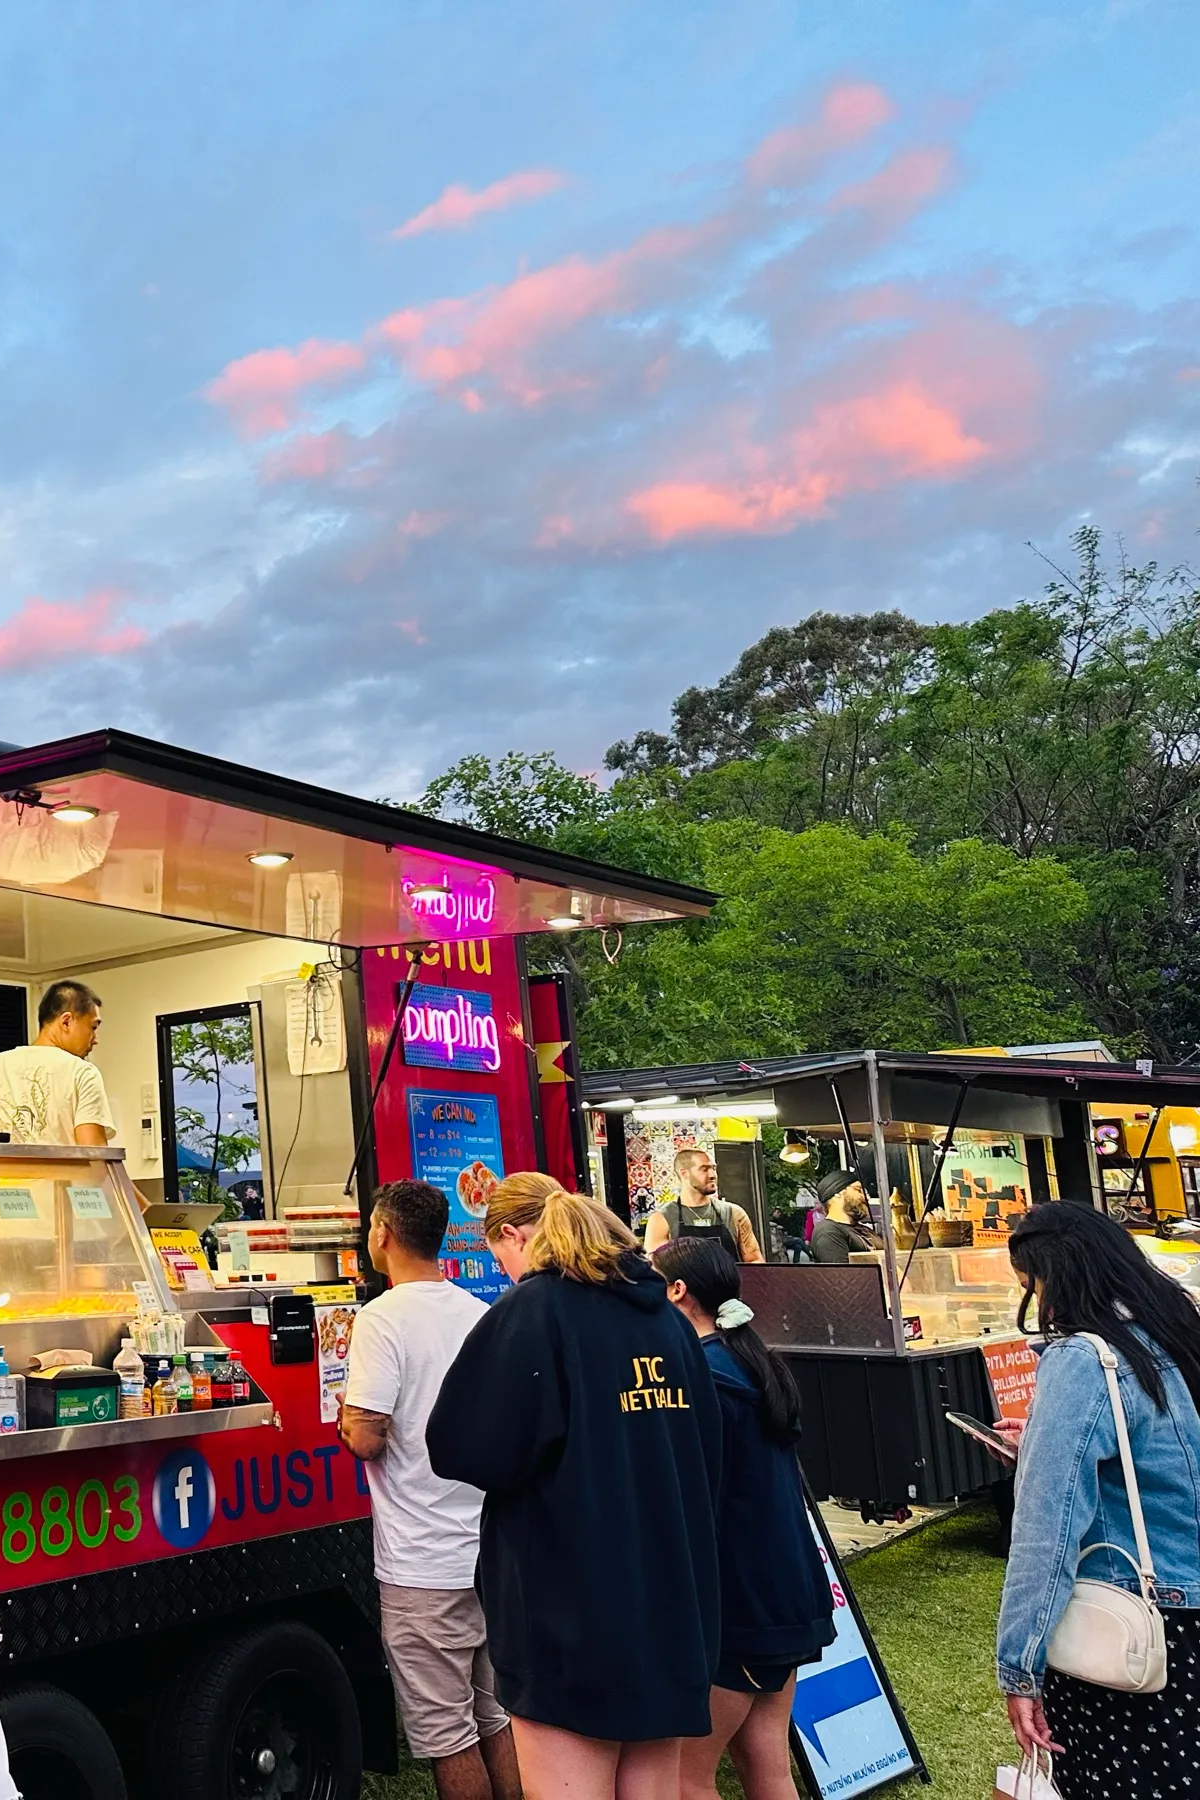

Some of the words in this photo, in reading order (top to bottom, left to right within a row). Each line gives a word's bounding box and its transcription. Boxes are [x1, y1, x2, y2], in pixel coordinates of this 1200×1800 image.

[431, 1104, 445, 1121] WE
[445, 1102, 462, 1120] CAN
[446, 1220, 486, 1238] AN-FRIE
[985, 1354, 1005, 1371] PITA
[632, 1356, 665, 1389] JTC
[993, 1373, 1016, 1392] RILLED
[220, 1445, 341, 1521] JUST
